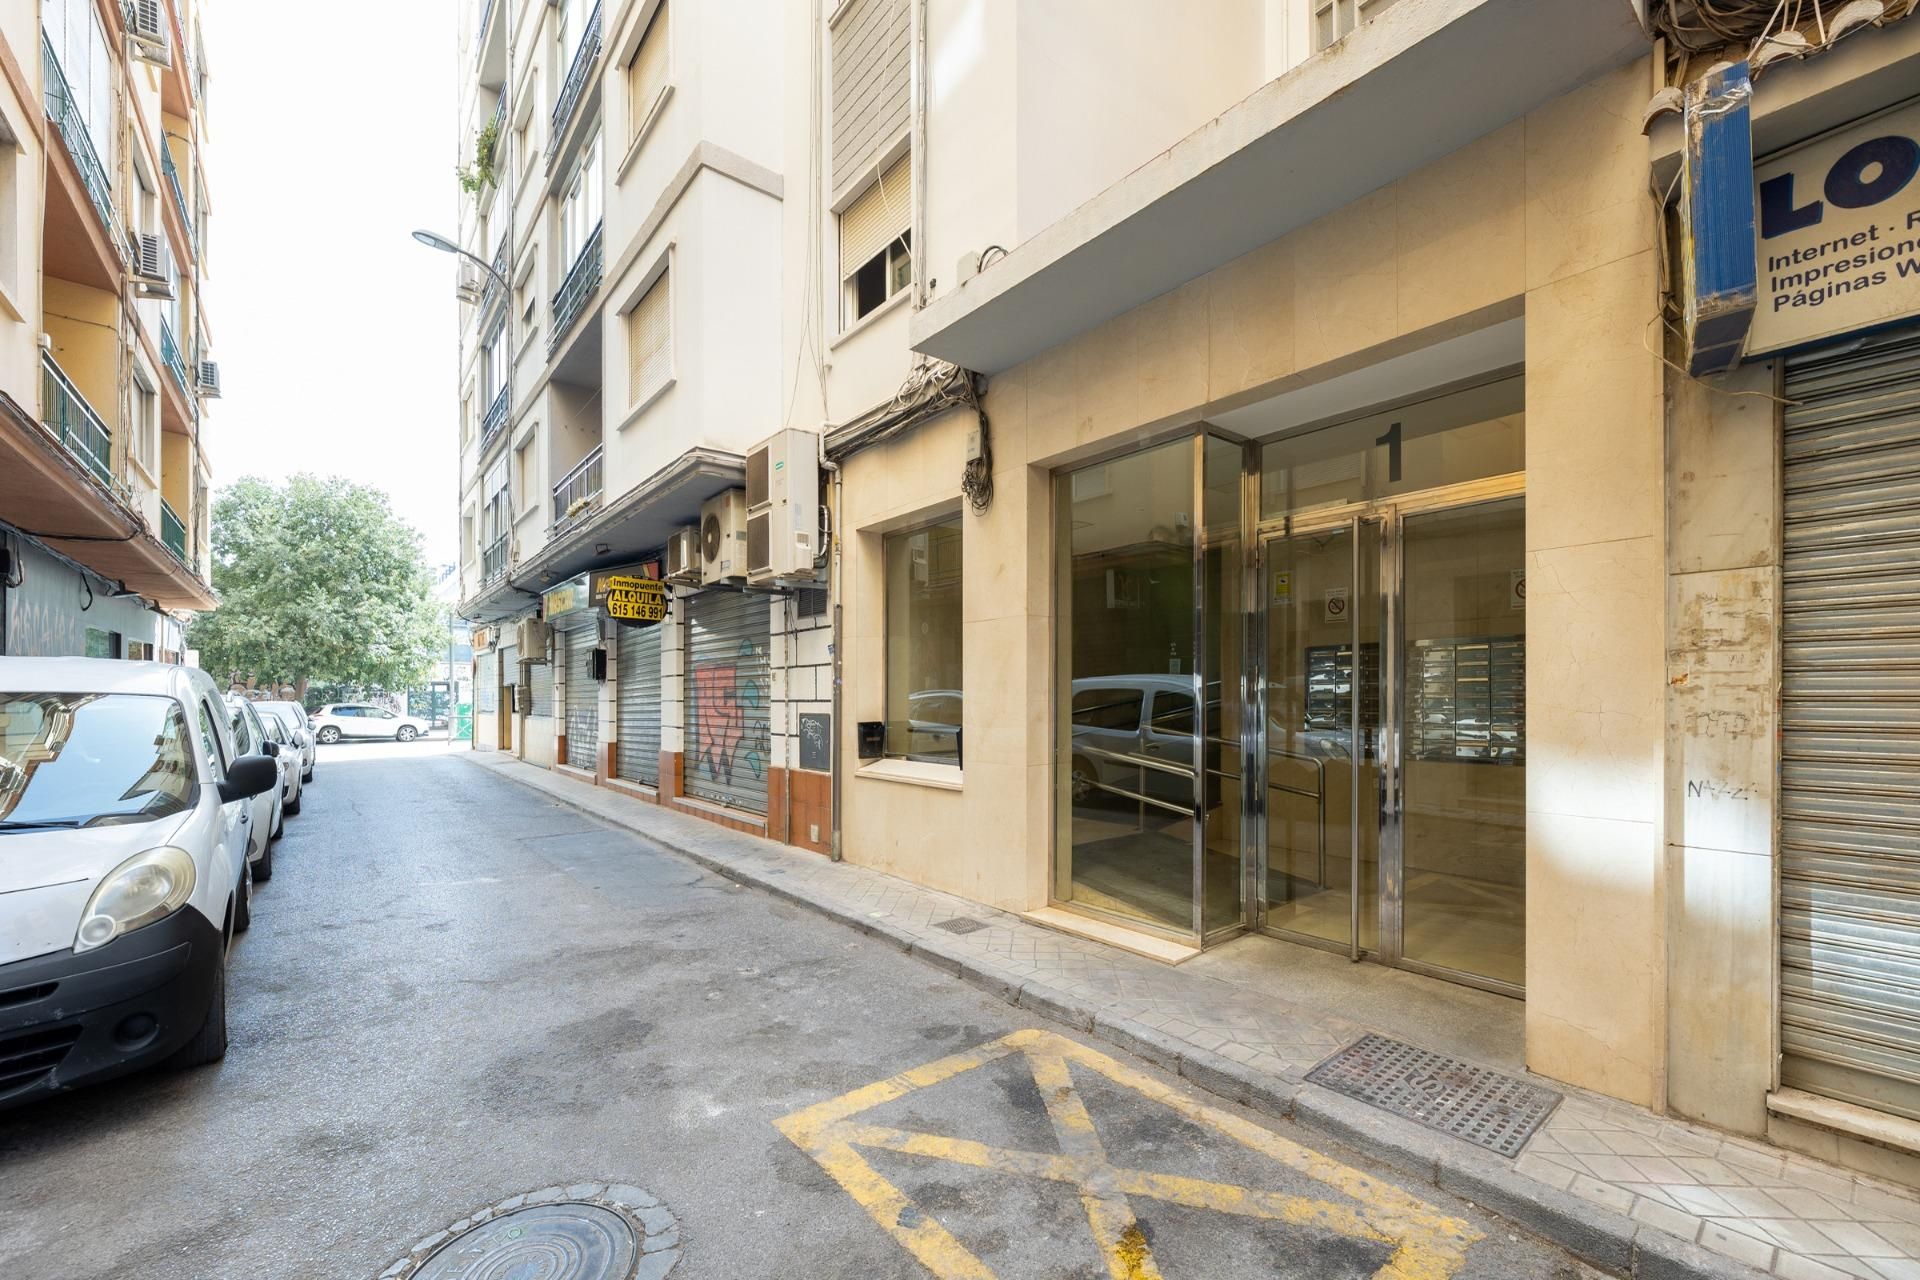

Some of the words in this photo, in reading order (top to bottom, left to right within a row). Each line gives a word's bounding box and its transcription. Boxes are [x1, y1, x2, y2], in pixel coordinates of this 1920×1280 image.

[1760, 136, 1920, 239] LO
[1769, 224, 1879, 272] Internet
[1772, 239, 1920, 292] Impresion
[1774, 271, 1887, 312] Páginas
[1376, 422, 1402, 482] 1
[613, 578, 663, 592] Inmopuente
[613, 591, 662, 605] ALQUILA
[612, 603, 628, 616] 615
[631, 605, 646, 618] 146
[648, 606, 663, 619] 991
